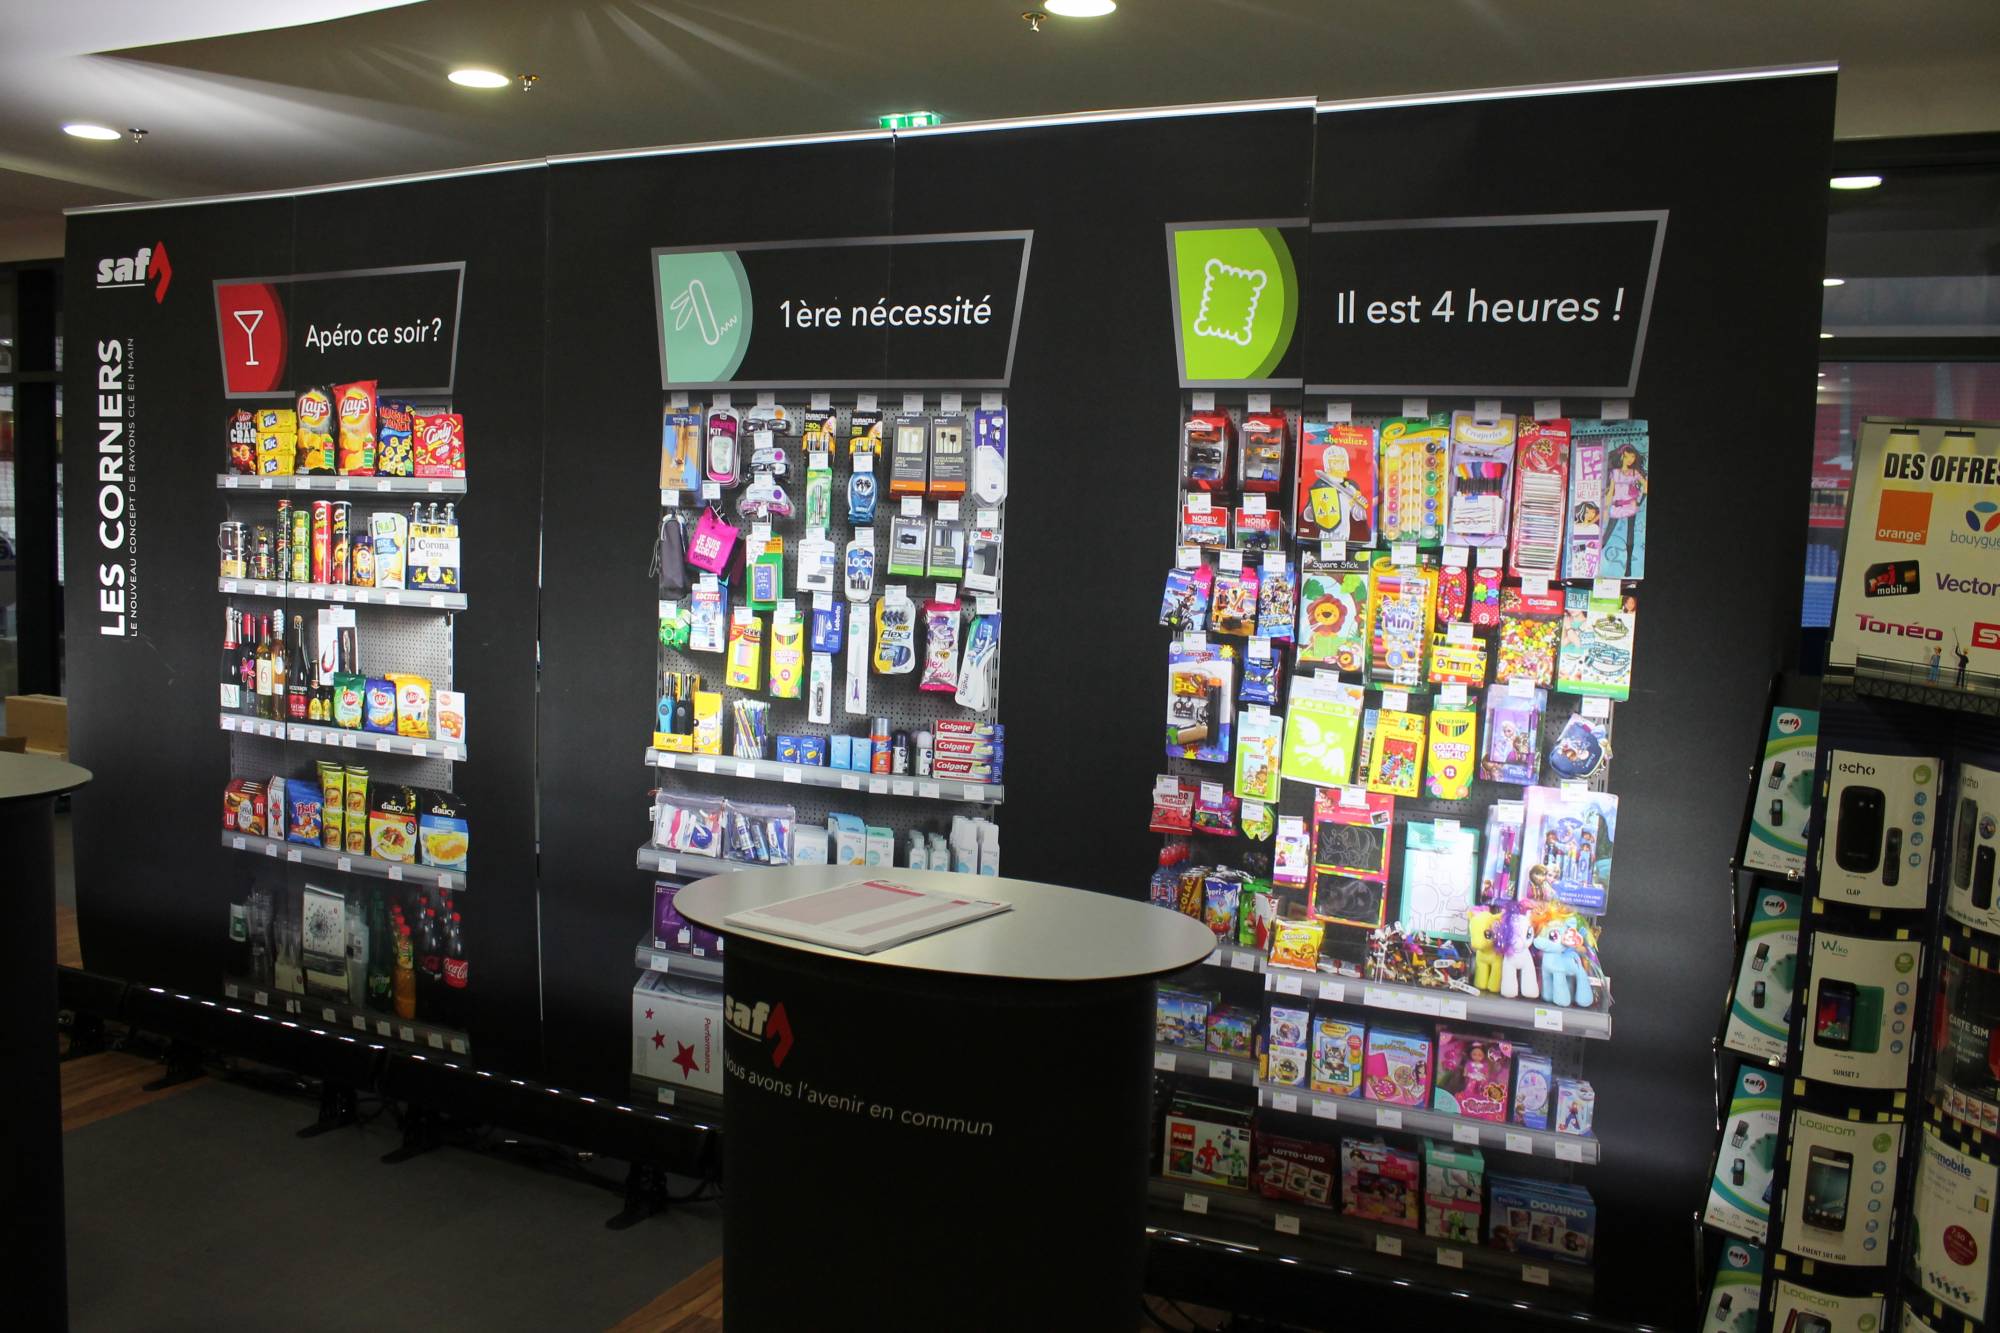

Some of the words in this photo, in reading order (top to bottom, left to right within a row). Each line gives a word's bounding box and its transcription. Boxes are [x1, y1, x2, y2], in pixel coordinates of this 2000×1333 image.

[97, 247, 151, 284] saf
[779, 300, 841, 328] 1ère
[851, 294, 992, 327] nécessité
[1336, 290, 1356, 324] Il
[1366, 295, 1421, 324] est
[1431, 290, 1455, 323] 4
[1467, 287, 1600, 323] heures
[1610, 287, 1625, 322] !
[306, 323, 363, 353] Apéro
[368, 327, 389, 345] ce
[128, 374, 135, 390] EN
[710, 427, 722, 436] KIT
[98, 339, 124, 549] CORNERS
[128, 422, 136, 471] RAYONS
[1884, 452, 1925, 480] DES
[129, 476, 136, 492] DE
[129, 498, 137, 554] CONCEPT
[1878, 528, 1921, 543] orange
[848, 556, 872, 568] LOCK
[1312, 561, 1338, 571] Square
[1340, 560, 1359, 569] Stick
[1877, 584, 1908, 595] mobile
[100, 563, 125, 636] LES
[130, 622, 138, 637] LE
[1384, 614, 1414, 630] Mini
[1855, 613, 1943, 642] Tonéo
[939, 722, 971, 731] Colgate
[938, 742, 971, 751] Colgate
[936, 761, 968, 771] Colgate
[1838, 763, 1876, 776] echo
[1846, 888, 1861, 897] CLAP
[1971, 1024, 1990, 1039] SIM
[1832, 1069, 1854, 1078] SUNSET
[749, 1071, 792, 1097] avons
[798, 1080, 864, 1113] l'avenir
[870, 1102, 893, 1120] en
[901, 1110, 993, 1136] commun
[1530, 1199, 1588, 1218] DOMINO
